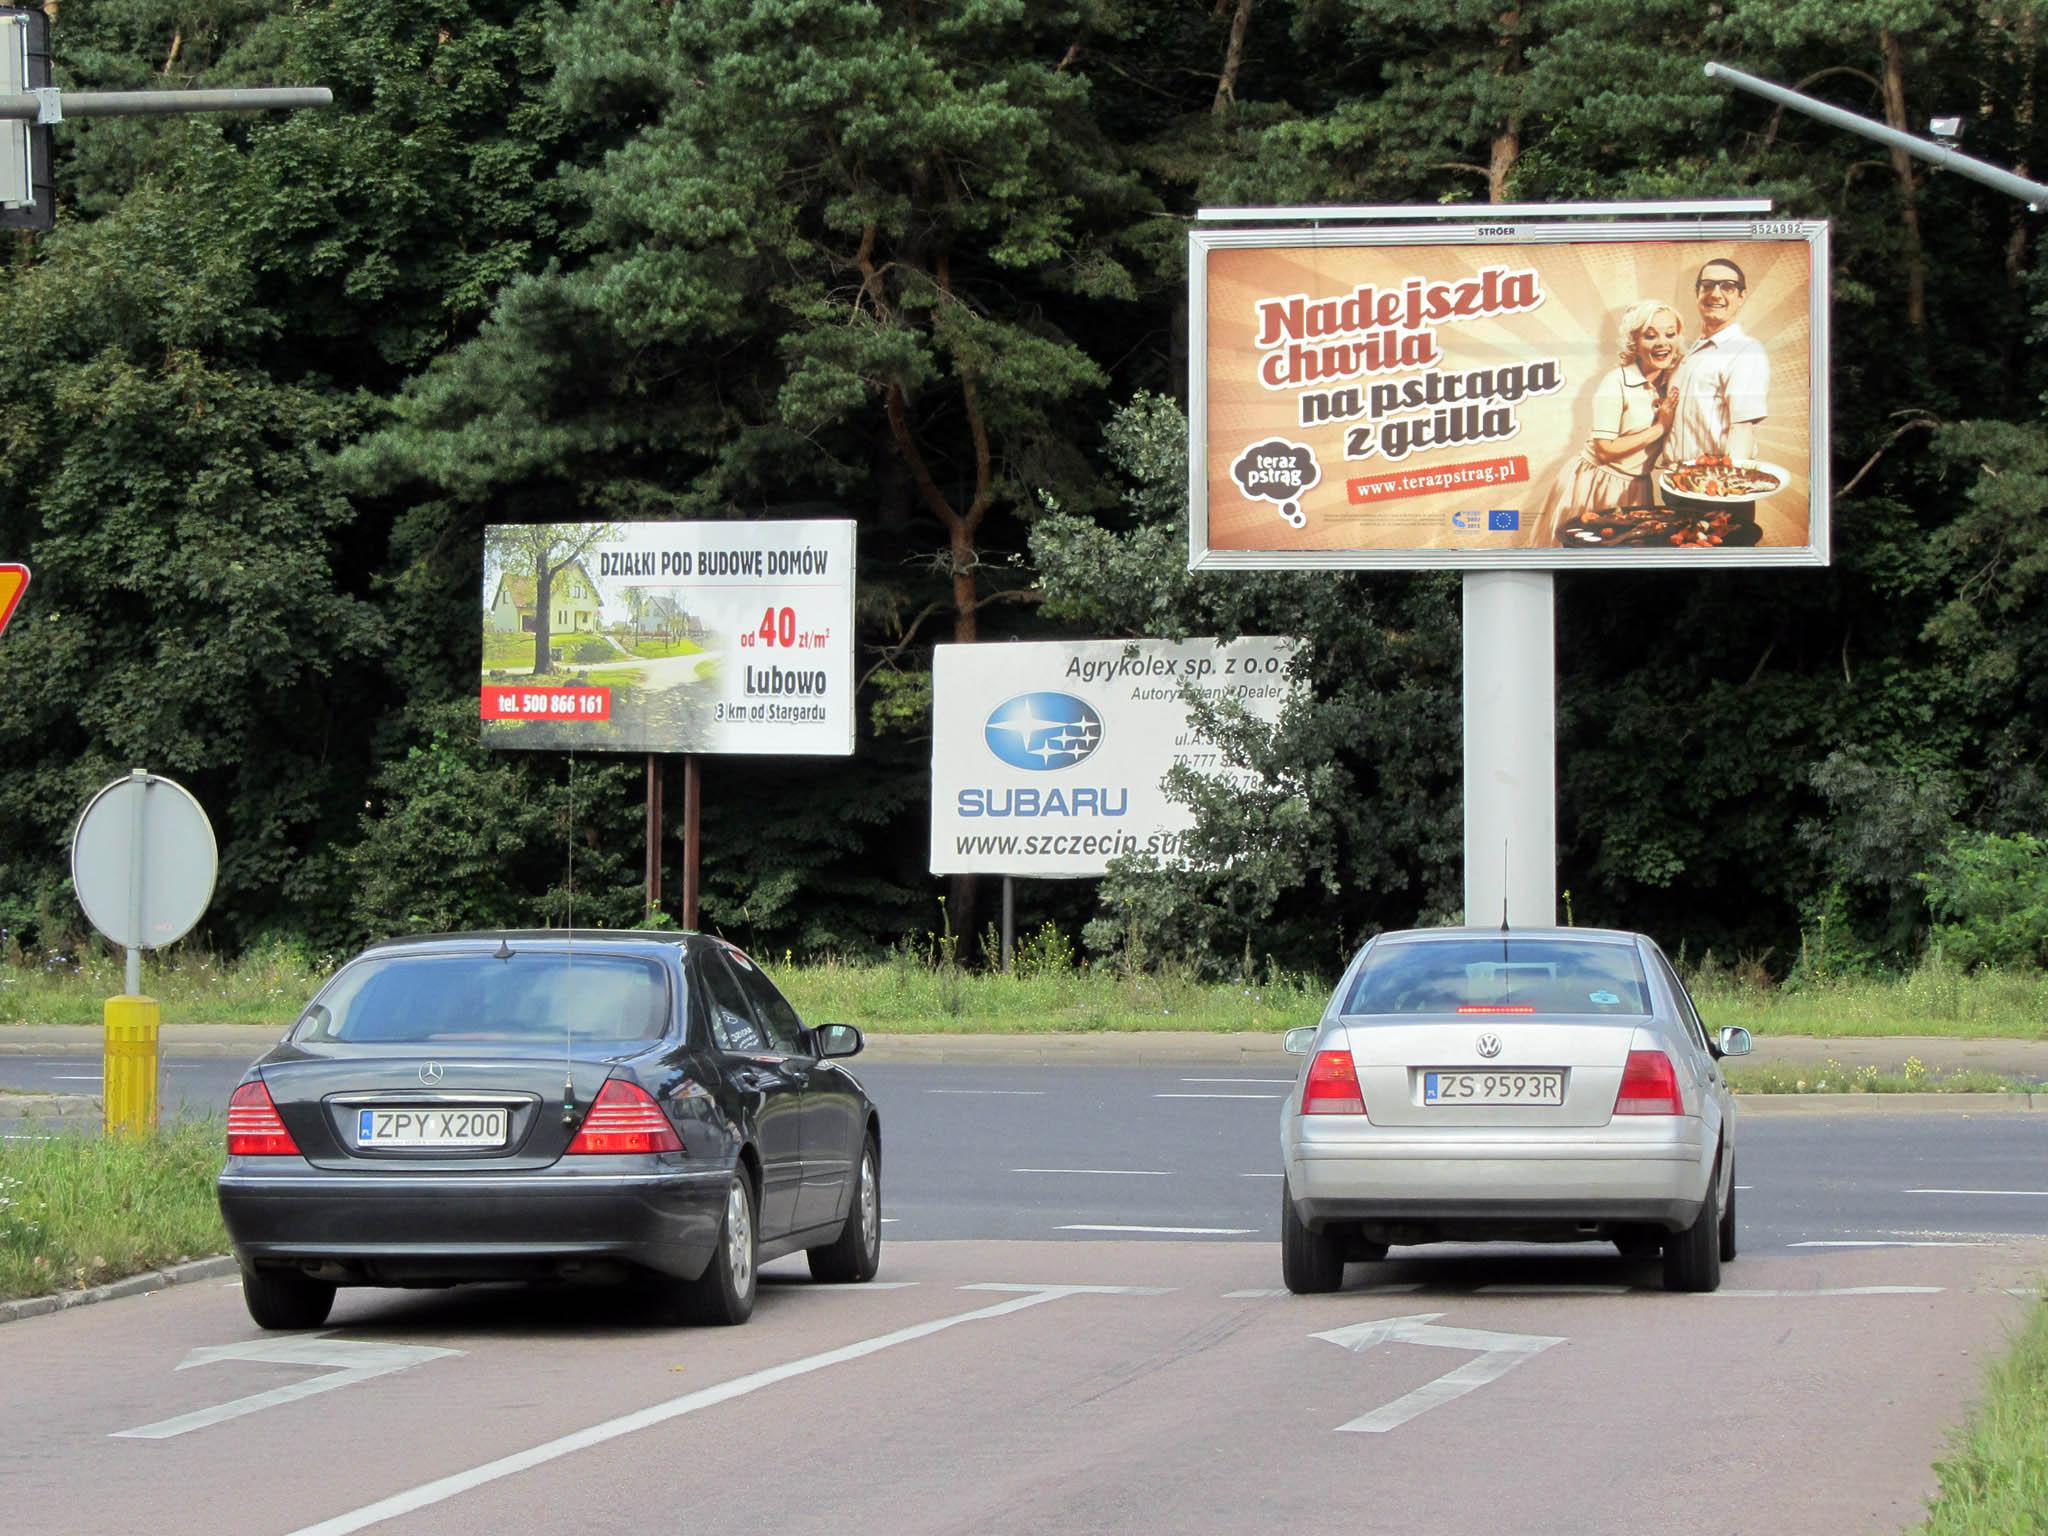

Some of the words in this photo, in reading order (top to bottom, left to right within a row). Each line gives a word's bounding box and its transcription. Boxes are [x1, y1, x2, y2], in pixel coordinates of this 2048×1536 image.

[1260, 270, 1540, 343] Nadejszła
[1263, 330, 1438, 385] chwila
[1303, 387, 1364, 423] na
[1348, 428, 1374, 455] z
[1257, 455, 1297, 469] teraz
[1248, 468, 1302, 487] pstrąg
[1357, 460, 1515, 497] www.terazpstrag.pl
[600, 552, 655, 576] DZIAŁKI
[661, 552, 692, 576] POD
[698, 551, 762, 577] BUDOWĘ
[767, 546, 828, 575] DOMÓW
[741, 630, 755, 647] od
[759, 607, 796, 647] 40
[747, 665, 826, 694] Lubowo
[1066, 655, 1178, 682] Agrykolex
[1184, 656, 1216, 680] sp.
[1225, 658, 1235, 673] z
[499, 694, 519, 712] tel.
[523, 694, 547, 712] 500
[551, 695, 575, 713] 866
[580, 695, 602, 713] 161
[1238, 684, 1283, 699] Dealer
[728, 704, 746, 719] km
[751, 704, 764, 719] od
[769, 704, 826, 721] Stargardu
[957, 788, 1128, 817] SUBARU
[1441, 1076, 1474, 1098] ZS
[1484, 1076, 1557, 1098] 9593R
[377, 1114, 430, 1138] ZPY
[440, 1114, 500, 1138] X200
